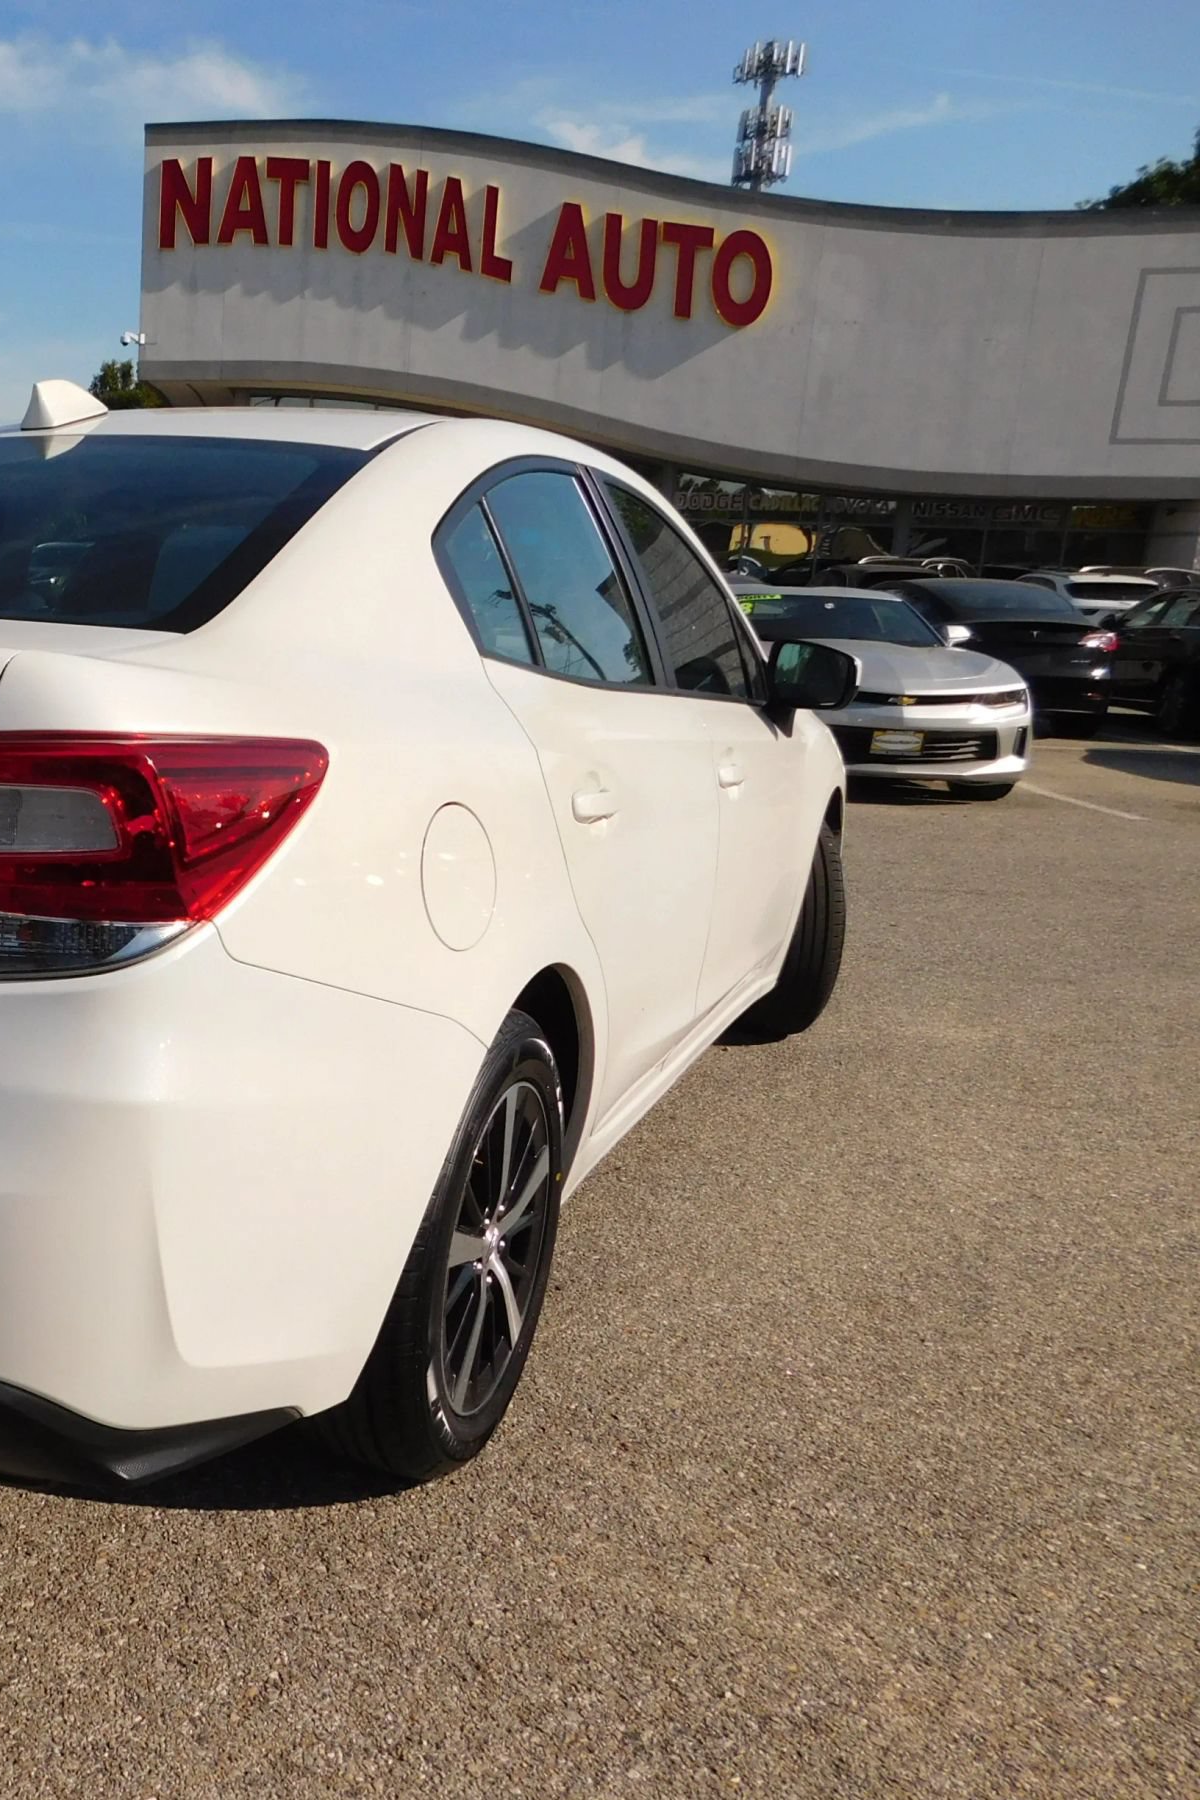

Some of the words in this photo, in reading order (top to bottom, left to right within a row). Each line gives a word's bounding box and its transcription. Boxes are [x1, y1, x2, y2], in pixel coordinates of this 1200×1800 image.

[157, 155, 513, 284] NATIONAL
[538, 201, 773, 329] AUTO
[677, 491, 745, 511] DODGE
[912, 502, 986, 518] NISSAN
[991, 504, 1062, 521] GMC
